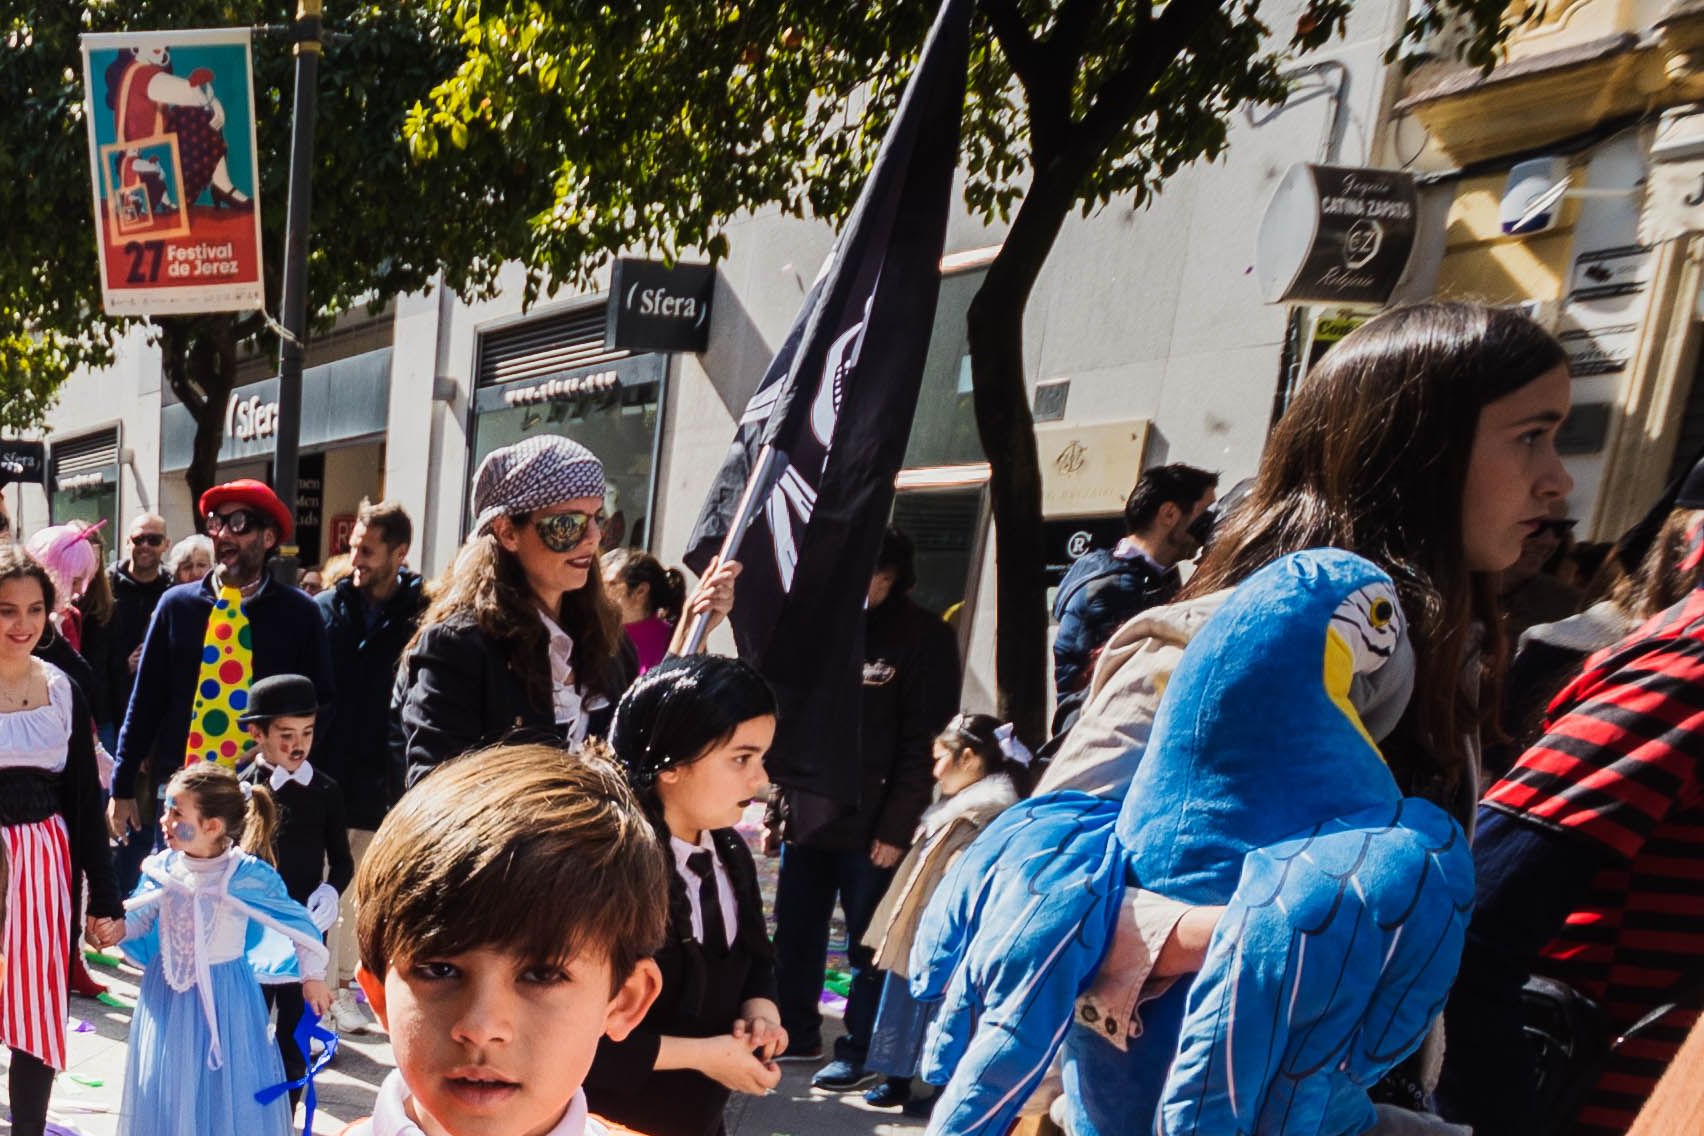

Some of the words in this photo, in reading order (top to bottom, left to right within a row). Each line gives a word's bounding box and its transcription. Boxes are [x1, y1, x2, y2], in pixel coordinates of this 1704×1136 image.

[124, 240, 166, 283] 27
[167, 243, 233, 260] Festival
[168, 261, 191, 277] de
[194, 260, 239, 275] Jerez
